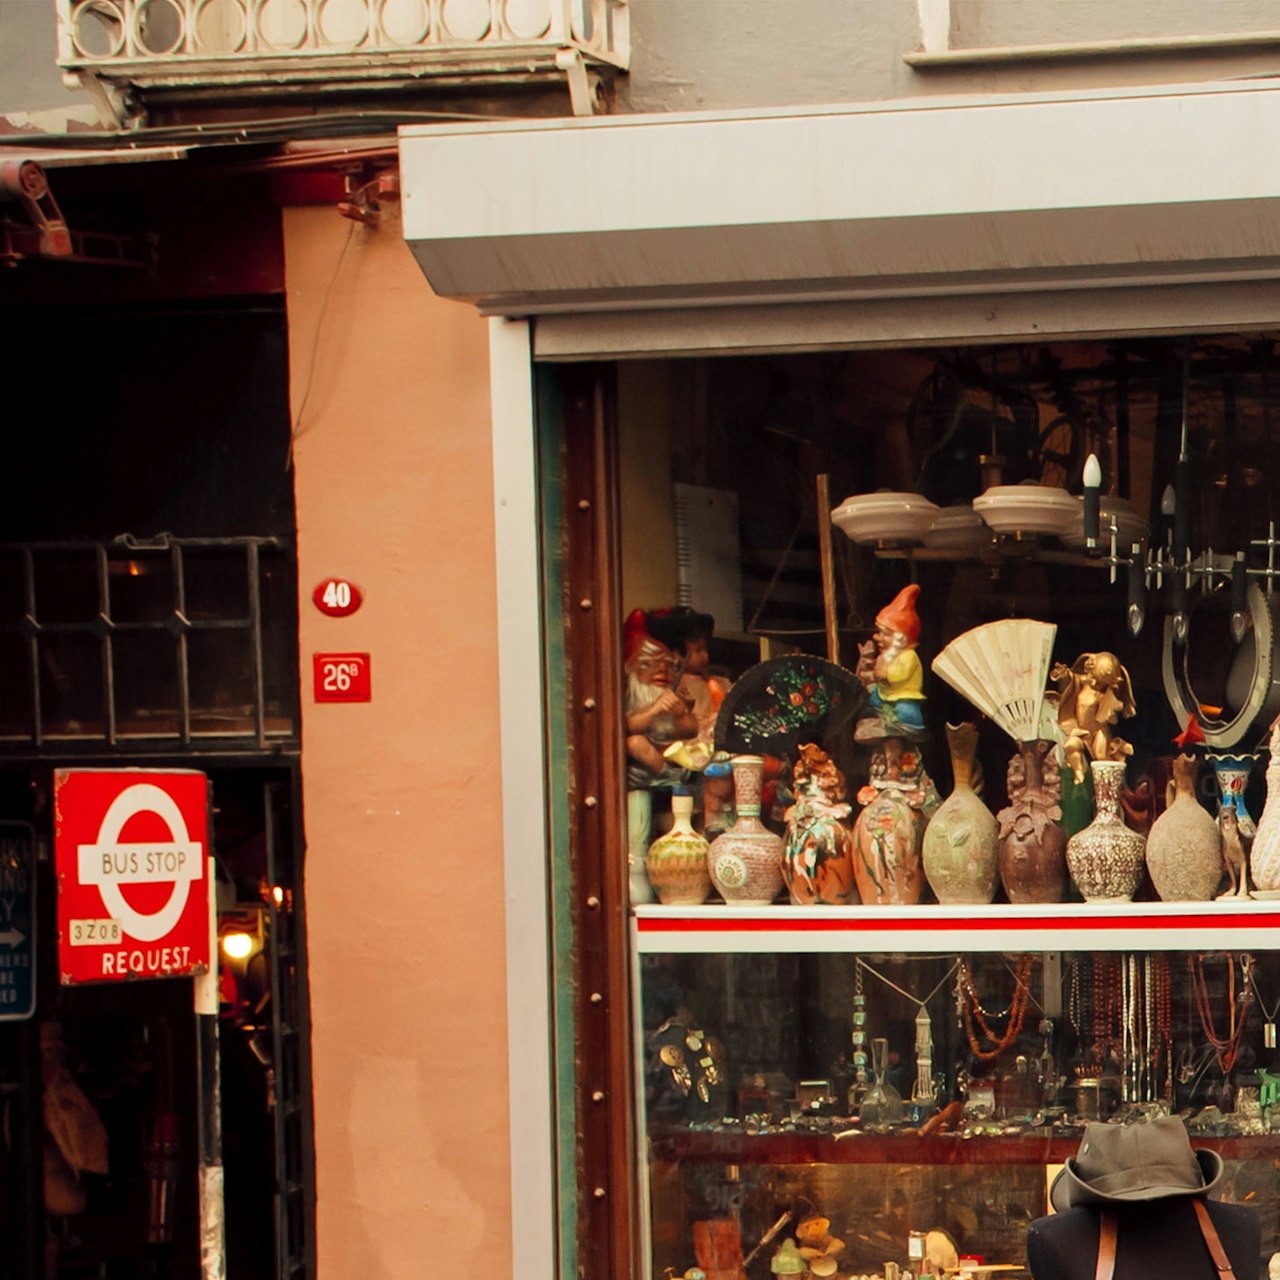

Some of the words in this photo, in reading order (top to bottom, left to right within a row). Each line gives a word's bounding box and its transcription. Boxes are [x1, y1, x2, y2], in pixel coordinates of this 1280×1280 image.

[323, 582, 351, 607] 40
[102, 852, 139, 875] BUS
[146, 851, 187, 874] STOP
[102, 946, 191, 975] REQUEST
